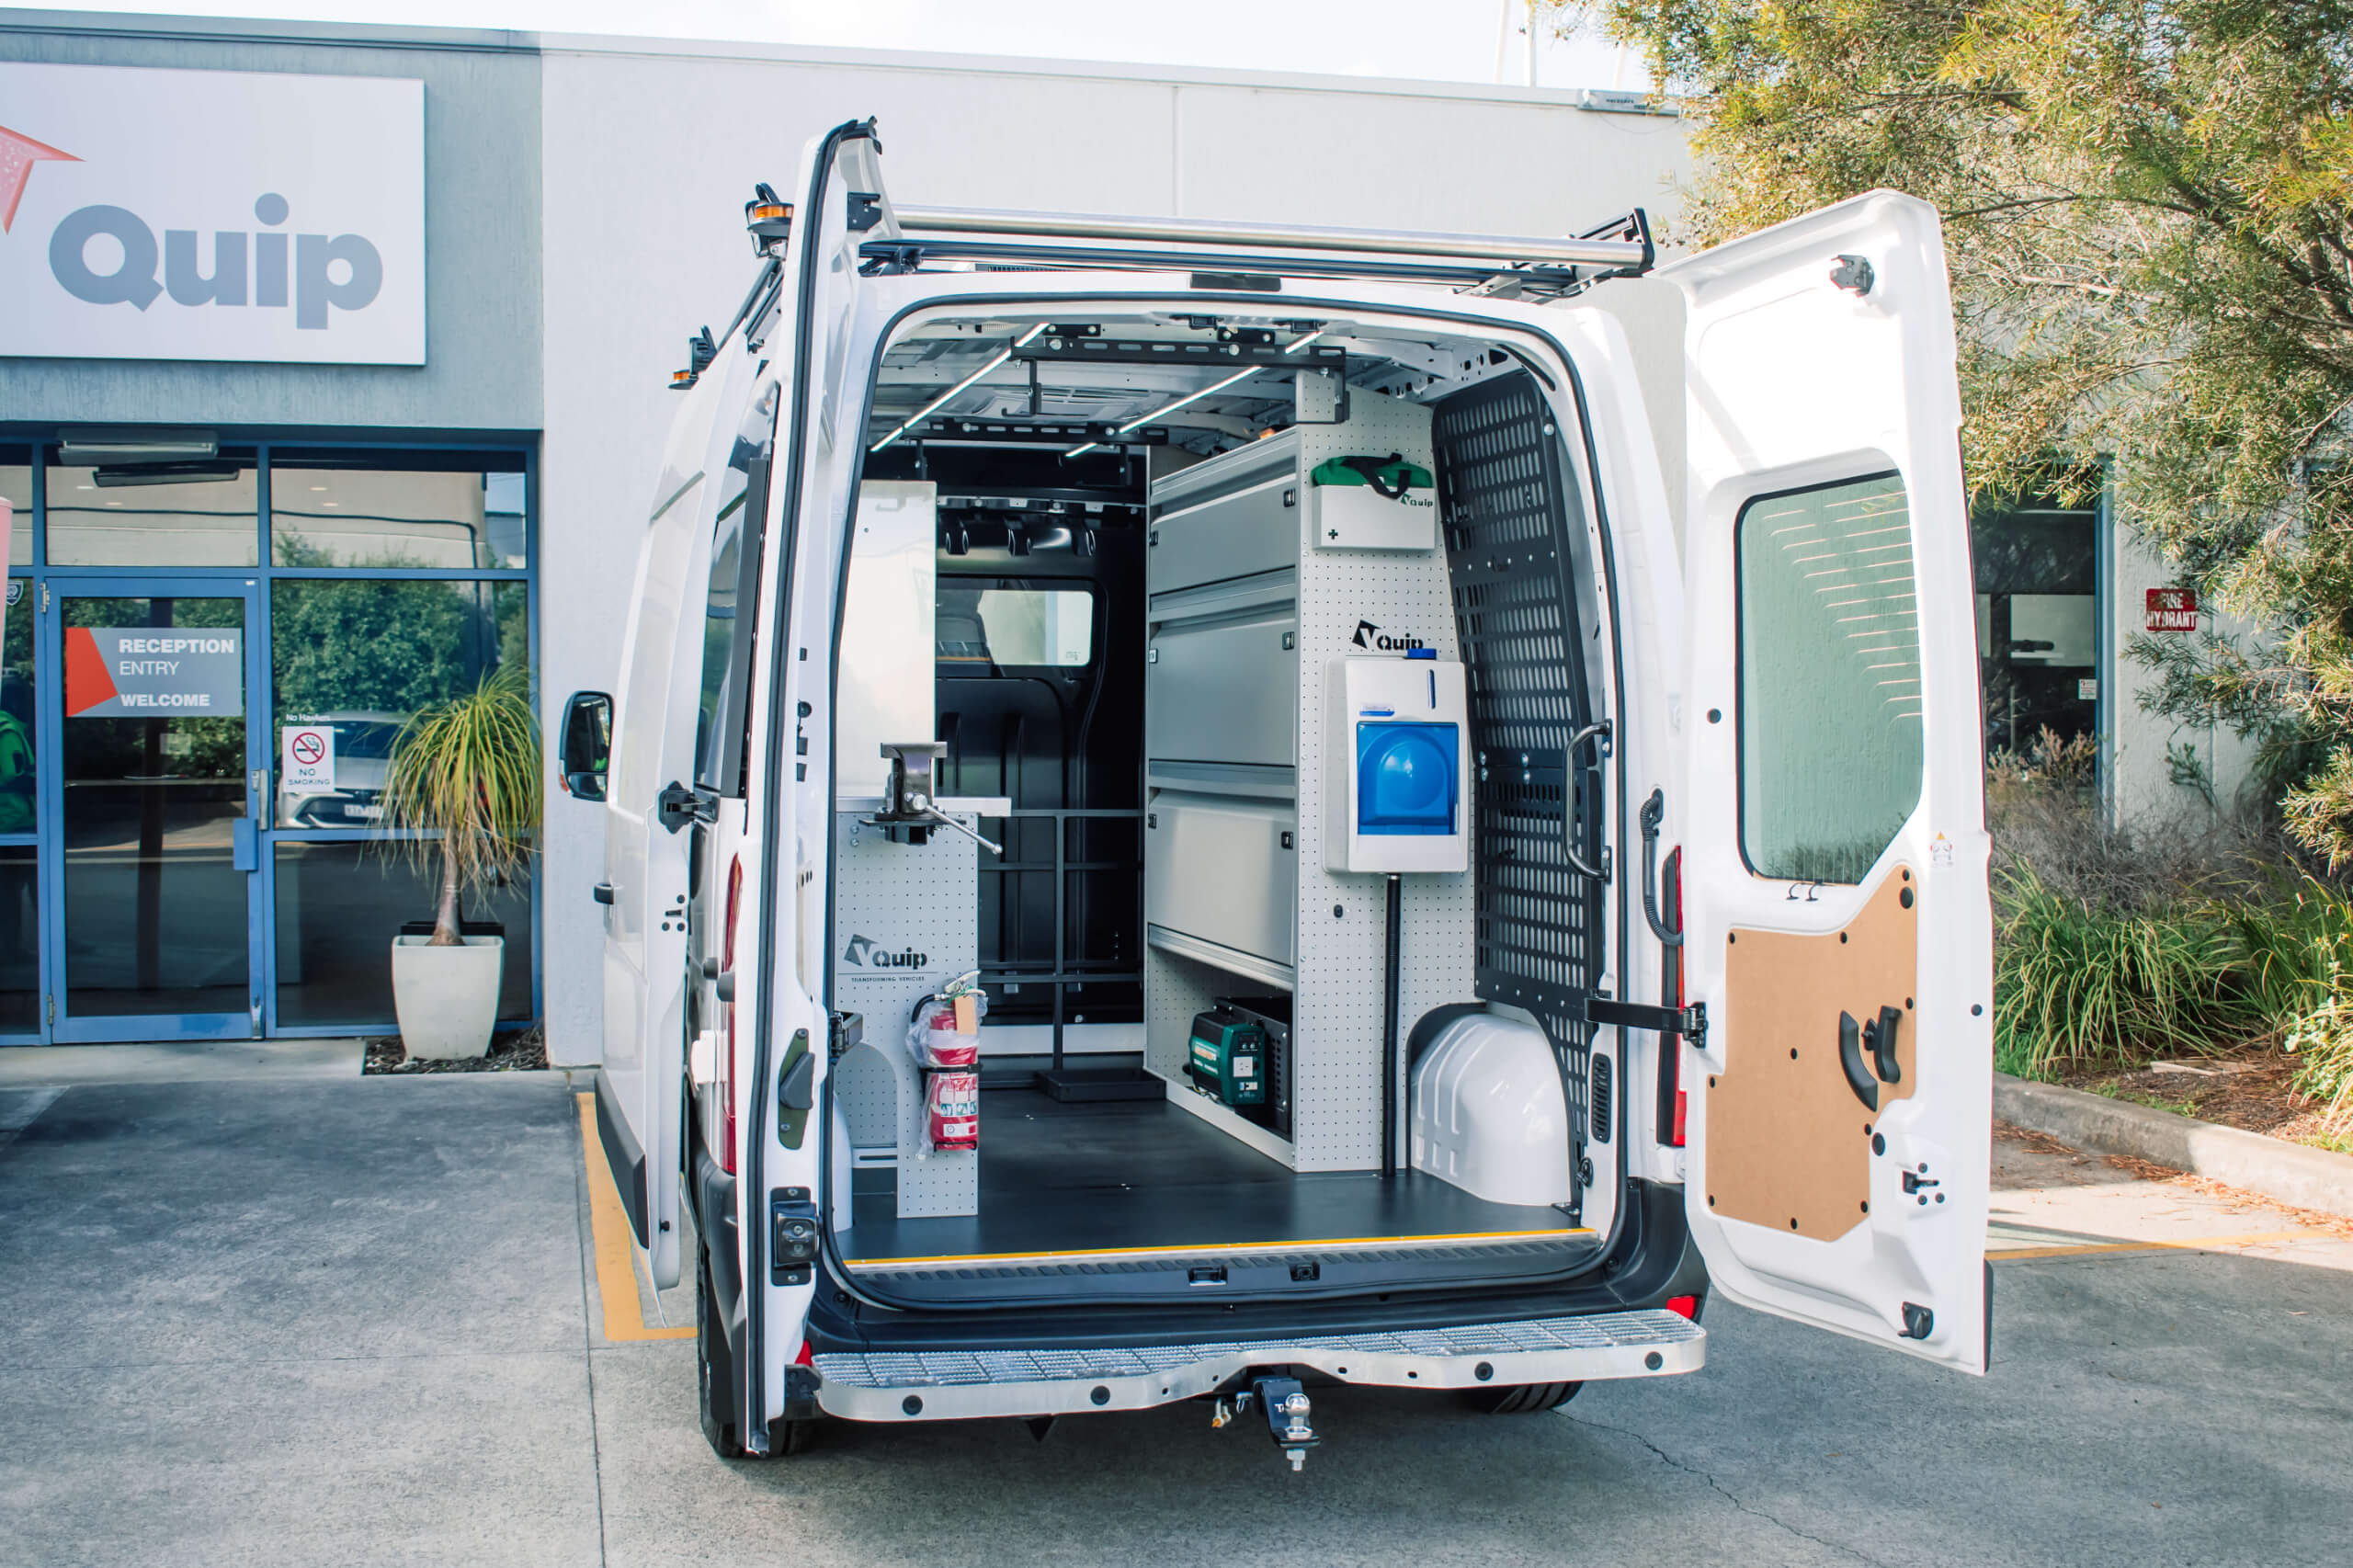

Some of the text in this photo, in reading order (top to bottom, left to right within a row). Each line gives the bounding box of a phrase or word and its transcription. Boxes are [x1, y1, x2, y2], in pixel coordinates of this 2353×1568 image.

[2146, 611, 2198, 627] HYDRANT
[119, 639, 235, 653] RECEPTION
[119, 661, 180, 676] ENTRY
[120, 694, 211, 707] WELCOME
[285, 713, 297, 722] No
[299, 768, 316, 777] NO
